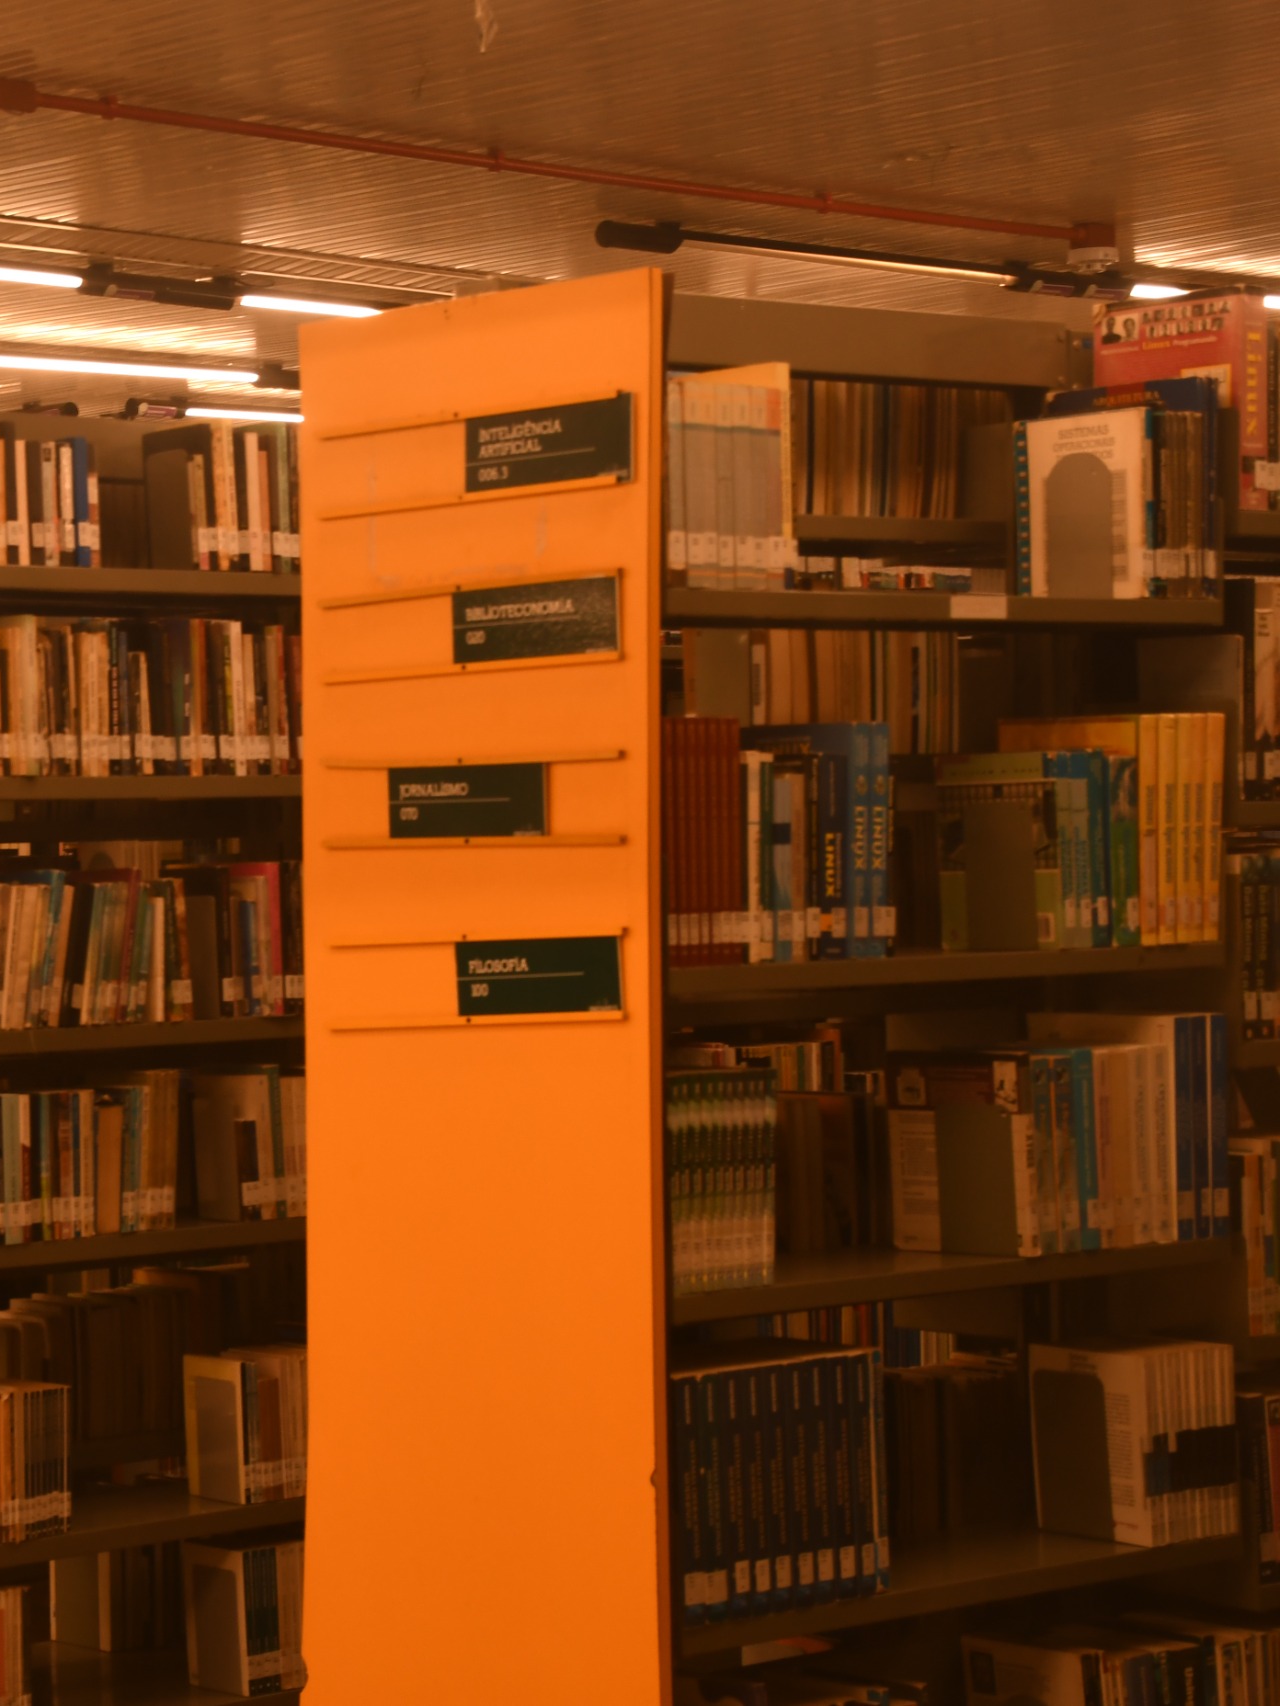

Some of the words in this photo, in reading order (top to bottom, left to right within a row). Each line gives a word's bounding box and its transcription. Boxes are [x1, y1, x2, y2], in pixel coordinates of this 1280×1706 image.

[478, 418, 562, 443] INTELIGÊNCIA
[478, 438, 543, 459] ARTIFICIAL
[465, 598, 575, 622] BIBLIOTECONOMIA
[399, 782, 469, 800] JORNALISMO
[854, 805, 868, 871] LINUX
[872, 805, 886, 871] LINUX
[825, 832, 835, 897] LINUX
[468, 957, 529, 974] FILOSOFIA
